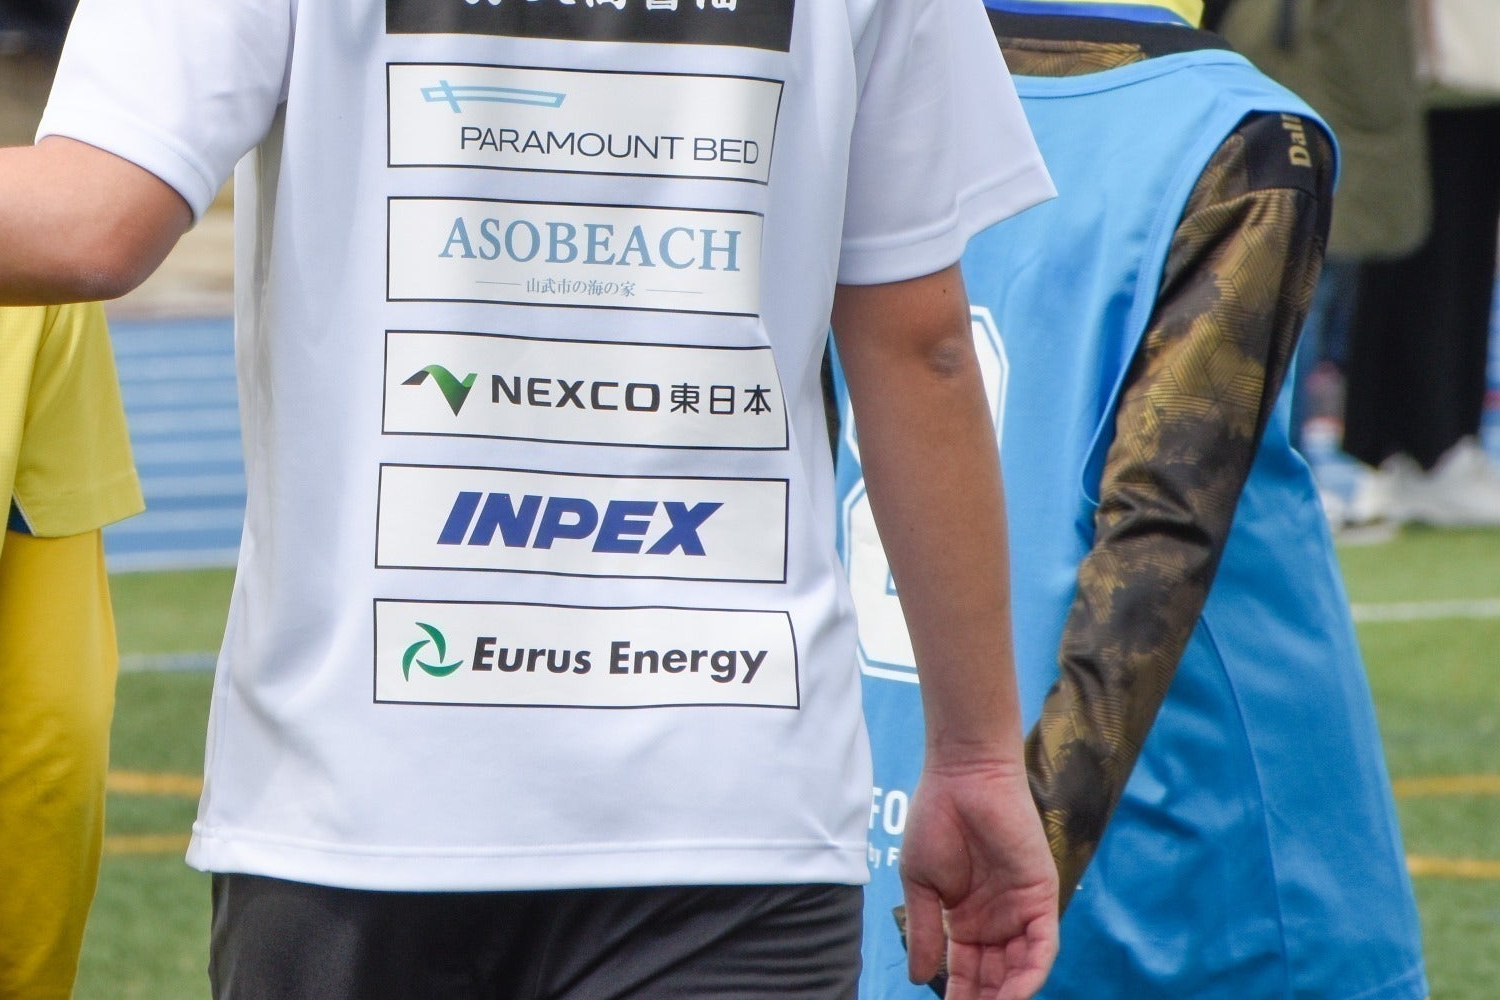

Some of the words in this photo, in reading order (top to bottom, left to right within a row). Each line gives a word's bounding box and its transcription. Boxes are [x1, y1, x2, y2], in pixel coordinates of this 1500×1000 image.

[460, 126, 684, 160] PARAMOUNT
[693, 137, 760, 165] BED
[438, 216, 742, 272] ASOBEACH
[526, 278, 635, 297] 山武市の海の家
[436, 490, 724, 556] INPEX
[472, 636, 591, 674] Eurus
[609, 641, 768, 684] Energy
